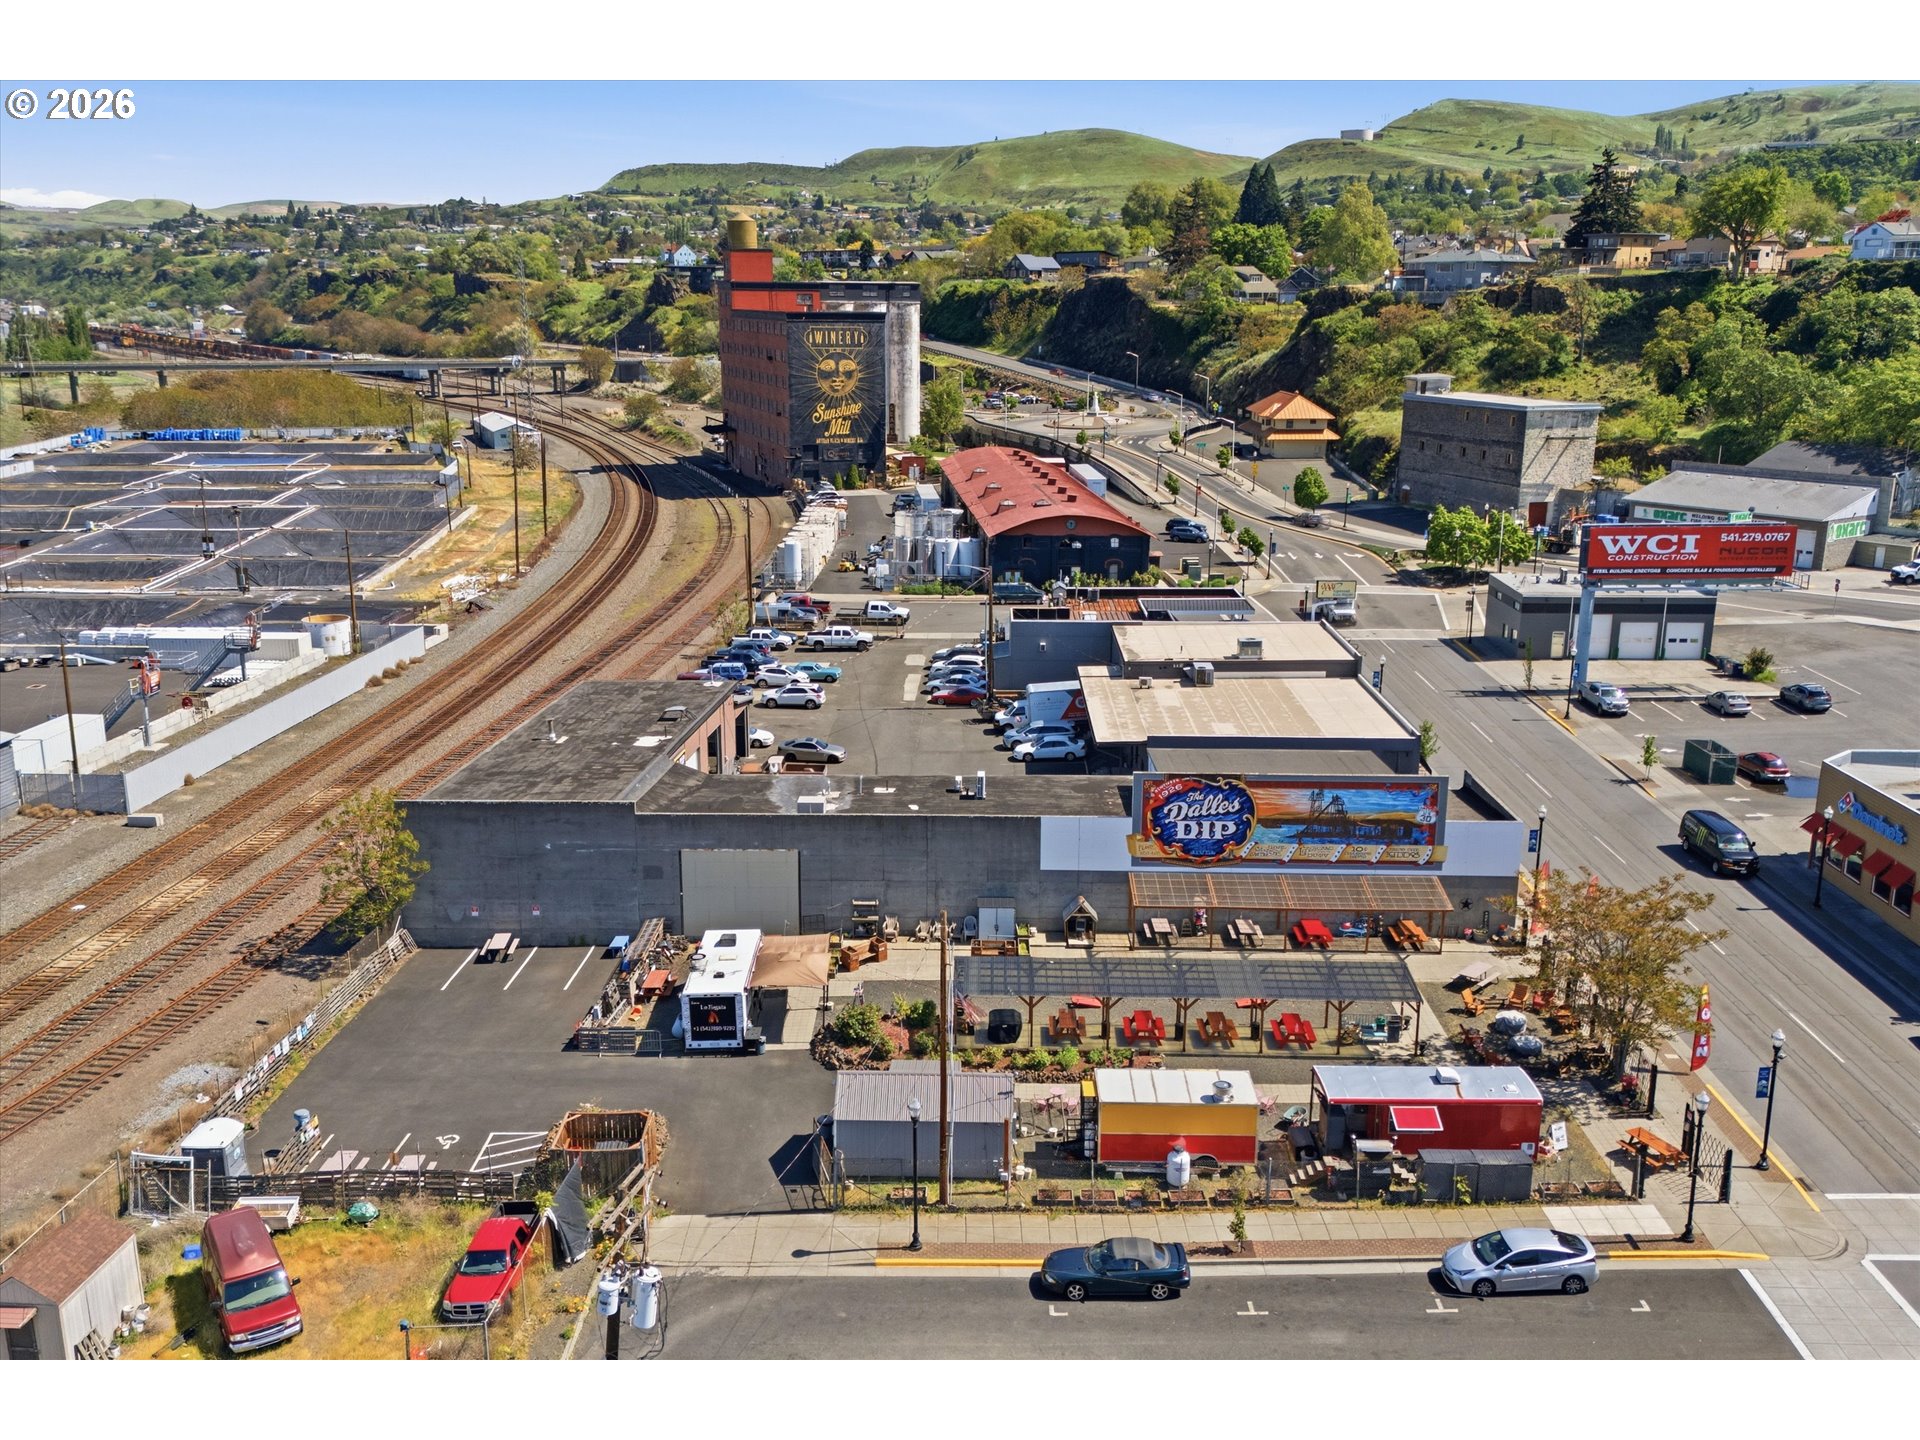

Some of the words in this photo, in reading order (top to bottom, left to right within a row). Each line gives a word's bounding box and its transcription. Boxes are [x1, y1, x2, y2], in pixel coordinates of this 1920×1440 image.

[813, 330, 859, 345] WINERY
[812, 400, 862, 424] Sunshine
[824, 418, 852, 437] Mill
[1653, 509, 1688, 522] oxarc
[1720, 532, 1791, 543] 541.279.0767
[1835, 521, 1865, 538] oxarc
[1598, 534, 1701, 554] WCI
[1719, 546, 1788, 556] NUCOR
[1159, 783, 1183, 800] 1926
[1187, 791, 1205, 802] The
[1164, 794, 1241, 823] Dalles
[1420, 814, 1432, 823] 30
[1852, 803, 1904, 845] Domino's
[1175, 820, 1237, 839] DIP
[1696, 1008, 1710, 1056] OEN
